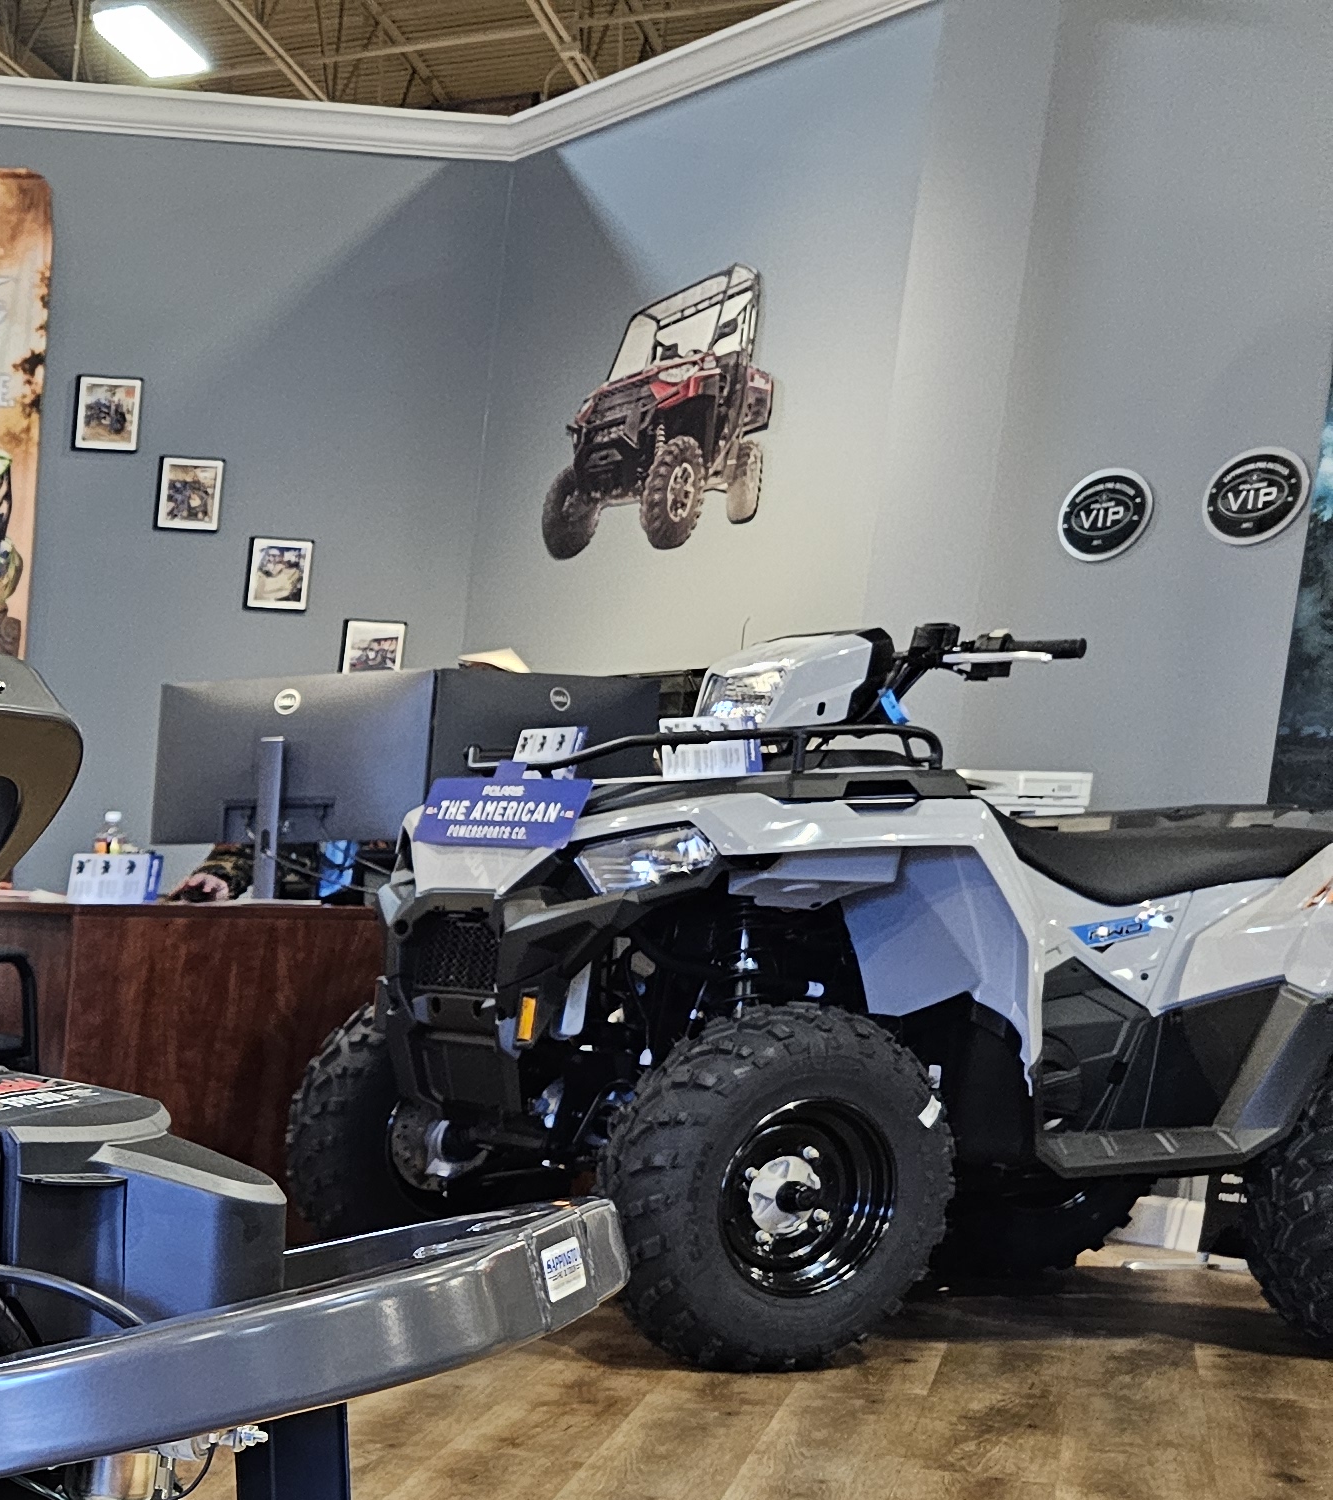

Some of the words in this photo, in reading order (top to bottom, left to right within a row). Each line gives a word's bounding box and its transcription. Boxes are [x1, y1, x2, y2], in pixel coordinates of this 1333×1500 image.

[1227, 487, 1277, 512] VIP
[1080, 506, 1124, 530] VIP
[437, 800, 470, 820] THE
[469, 801, 562, 823] AMERICAN
[446, 824, 512, 839] POWERSPORTS
